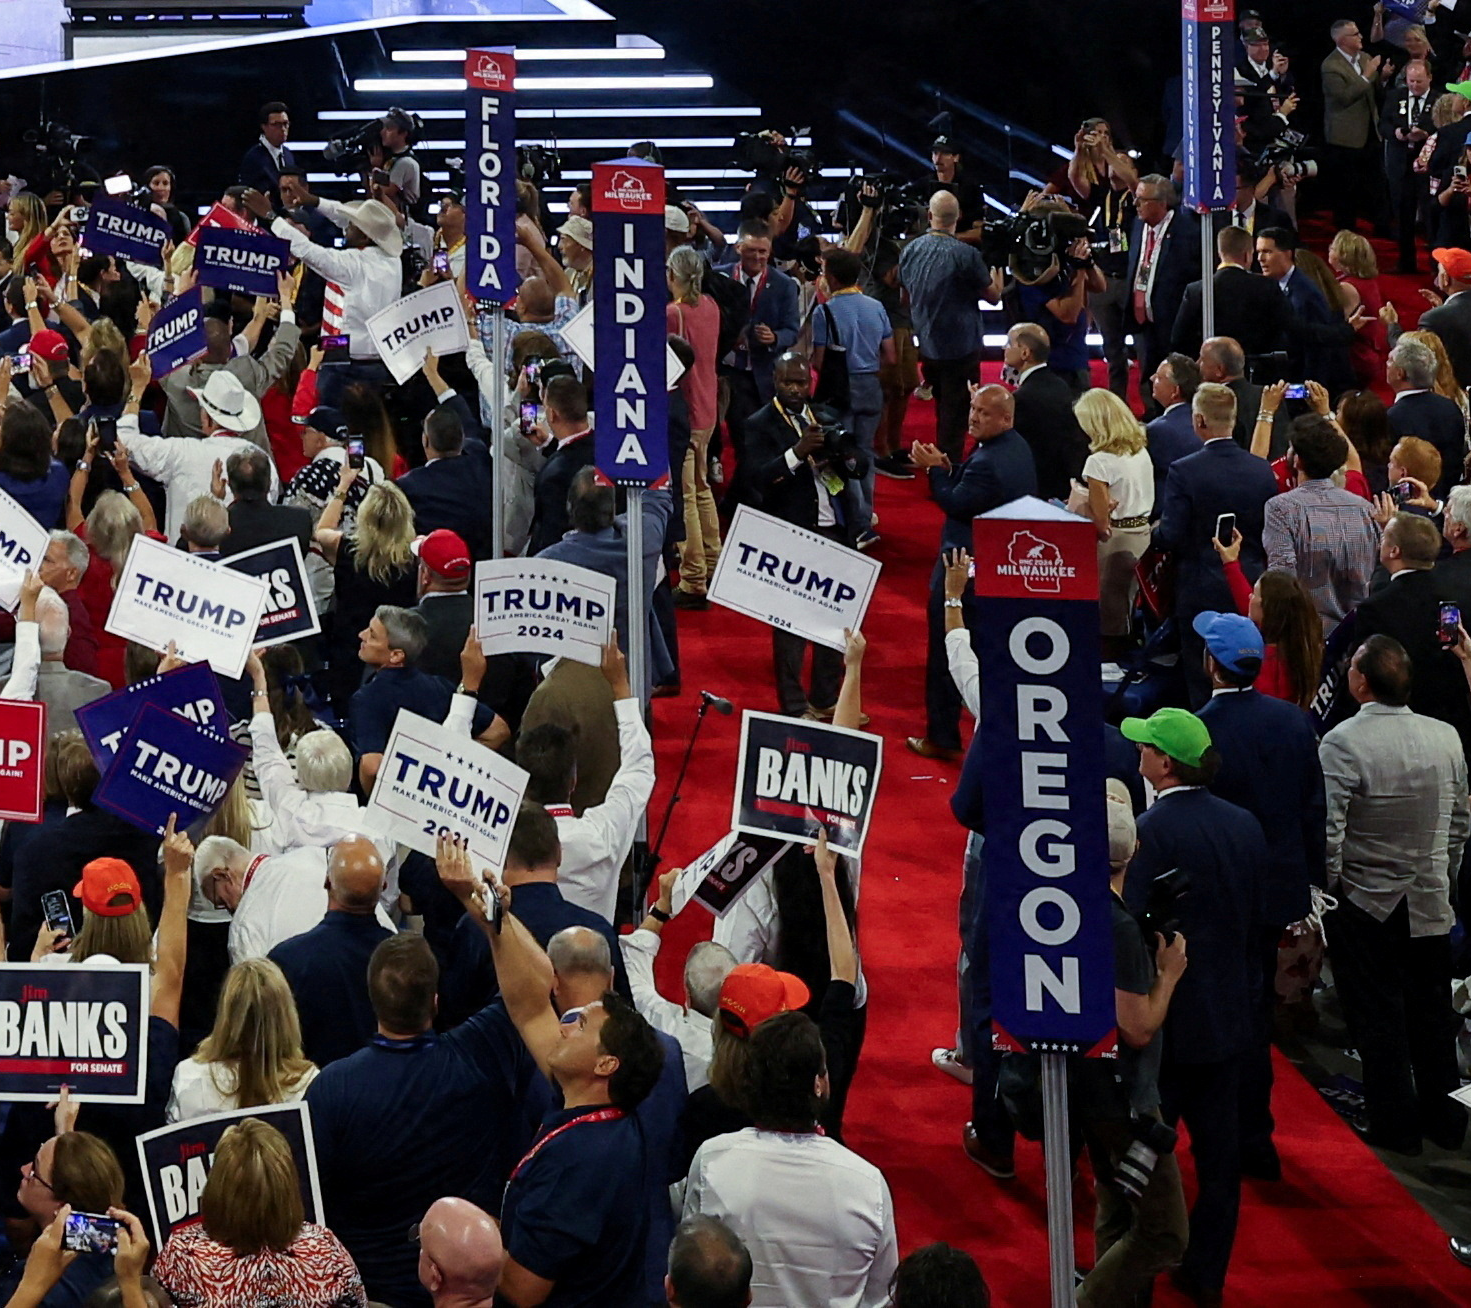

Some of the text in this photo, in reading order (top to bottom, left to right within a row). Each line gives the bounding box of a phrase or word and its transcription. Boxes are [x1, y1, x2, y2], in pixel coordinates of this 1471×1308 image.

[473, 71, 505, 80] MILWAUKEE
[1187, 24, 1195, 199] PENNSYLVANIA
[1211, 27, 1223, 201] PENNSYLVANIA
[480, 97, 502, 290] FLORIDA
[605, 192, 652, 202] MILWAUKEE
[96, 211, 167, 244] TRUMP
[203, 245, 280, 269] TRUMP
[148, 308, 198, 348] TRUMP
[382, 307, 455, 350] TRUMP
[615, 224, 648, 465] INDIANA
[739, 542, 856, 603] TRUMP
[997, 565, 1075, 577] MILWAUKEE
[136, 574, 246, 629] TRUMP
[482, 588, 605, 621] TRUMP
[768, 615, 792, 628] 2024
[517, 625, 565, 641] 2024
[135, 740, 227, 804] TRUMP
[395, 752, 510, 828] TRUMP
[758, 747, 865, 817] BANKS
[392, 786, 458, 819] MAKE AMERICA
[1008, 617, 1081, 1015] OREGON
[19, 985, 47, 1002] Jim
[70, 1063, 122, 1074] FOR SENATE
